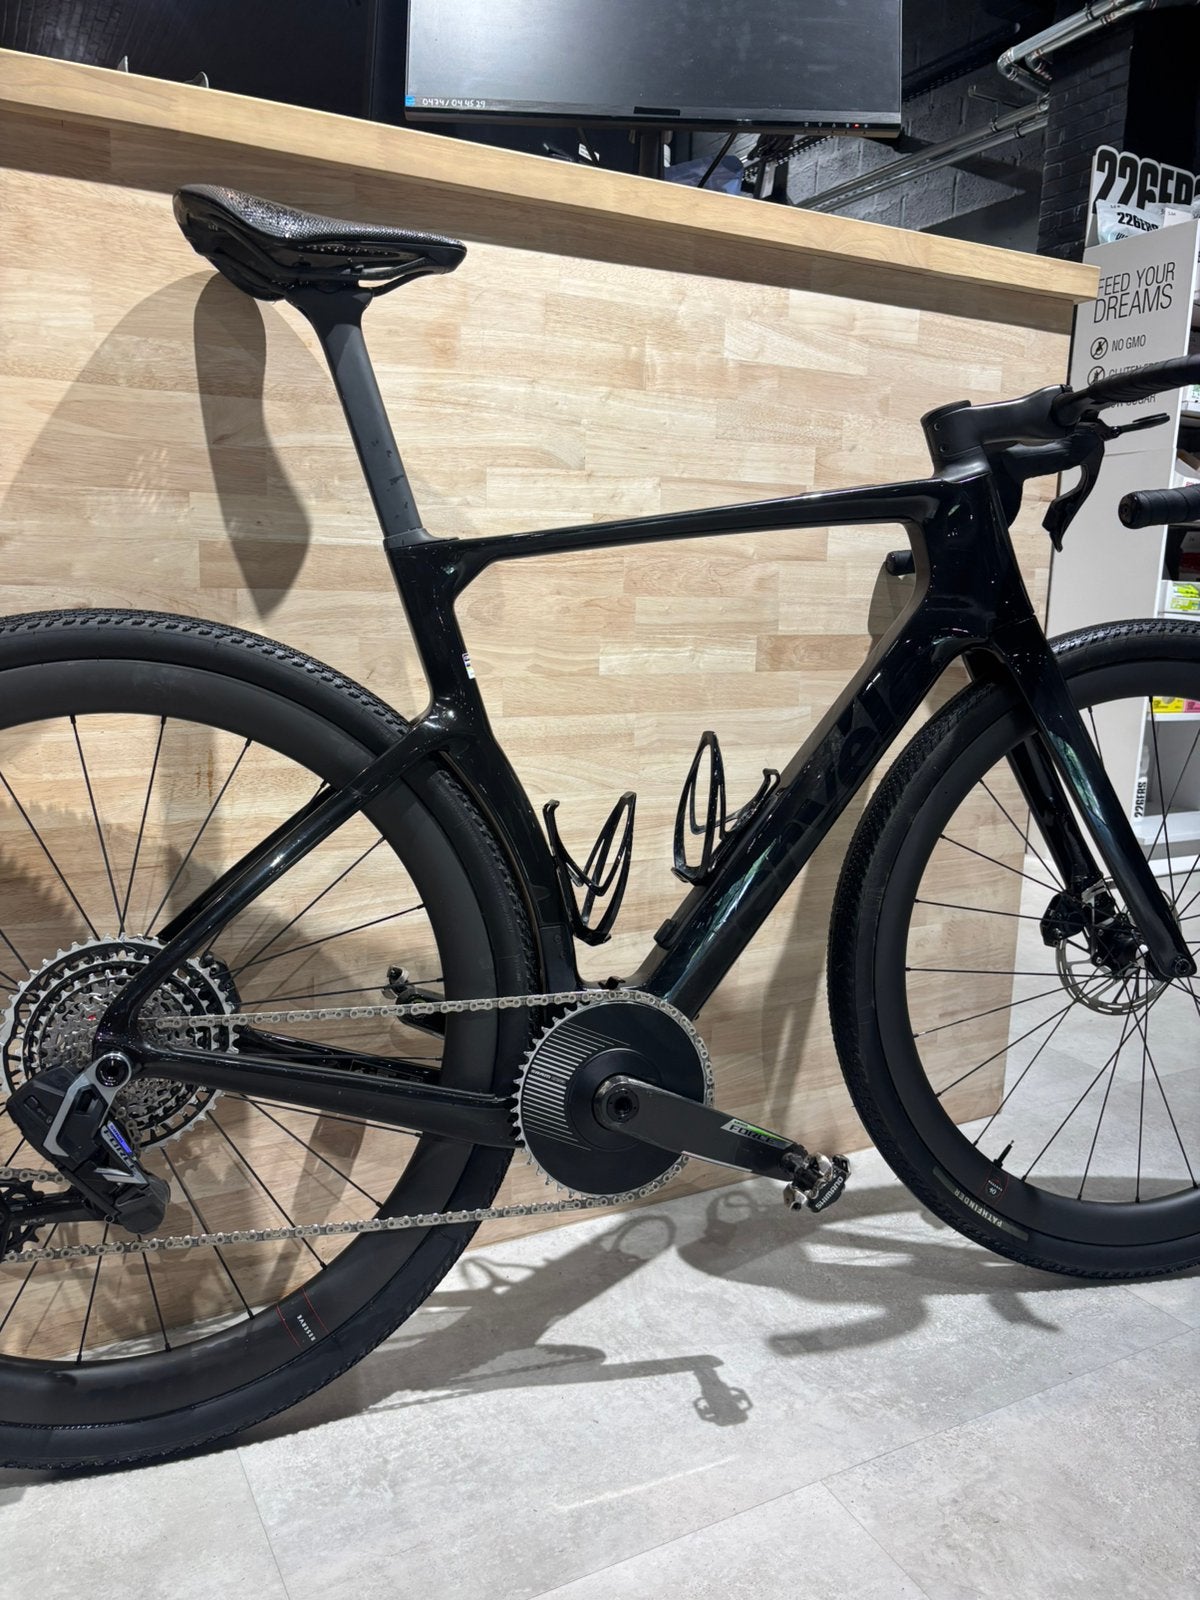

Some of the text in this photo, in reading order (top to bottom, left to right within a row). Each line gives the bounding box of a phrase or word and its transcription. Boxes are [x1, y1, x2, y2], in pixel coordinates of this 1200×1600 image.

[1092, 149, 1200, 215] 226ER
[1137, 262, 1175, 288] YOUR
[1094, 283, 1172, 323] DREAMS
[1111, 334, 1147, 352] NO GMO
[815, 1175, 844, 1210] SHIMANO
[954, 1188, 1003, 1228] PATHFINDER
[297, 1314, 316, 1341] RESERVE
